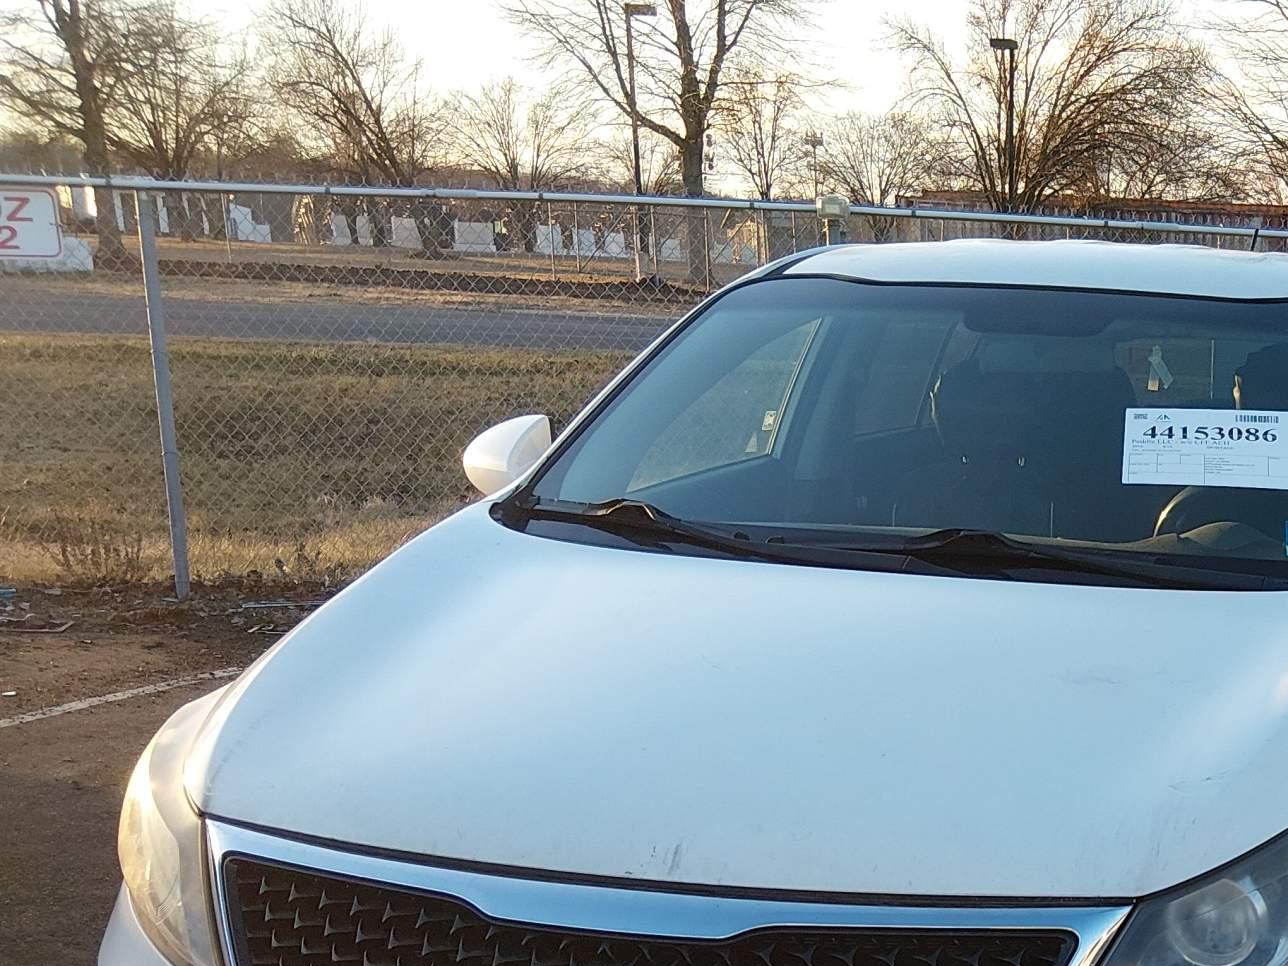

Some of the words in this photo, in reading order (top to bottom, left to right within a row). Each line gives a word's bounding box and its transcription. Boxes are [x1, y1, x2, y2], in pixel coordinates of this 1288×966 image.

[0, 196, 34, 222] Z
[0, 225, 21, 250] 2
[1142, 425, 1279, 443] 44153086
